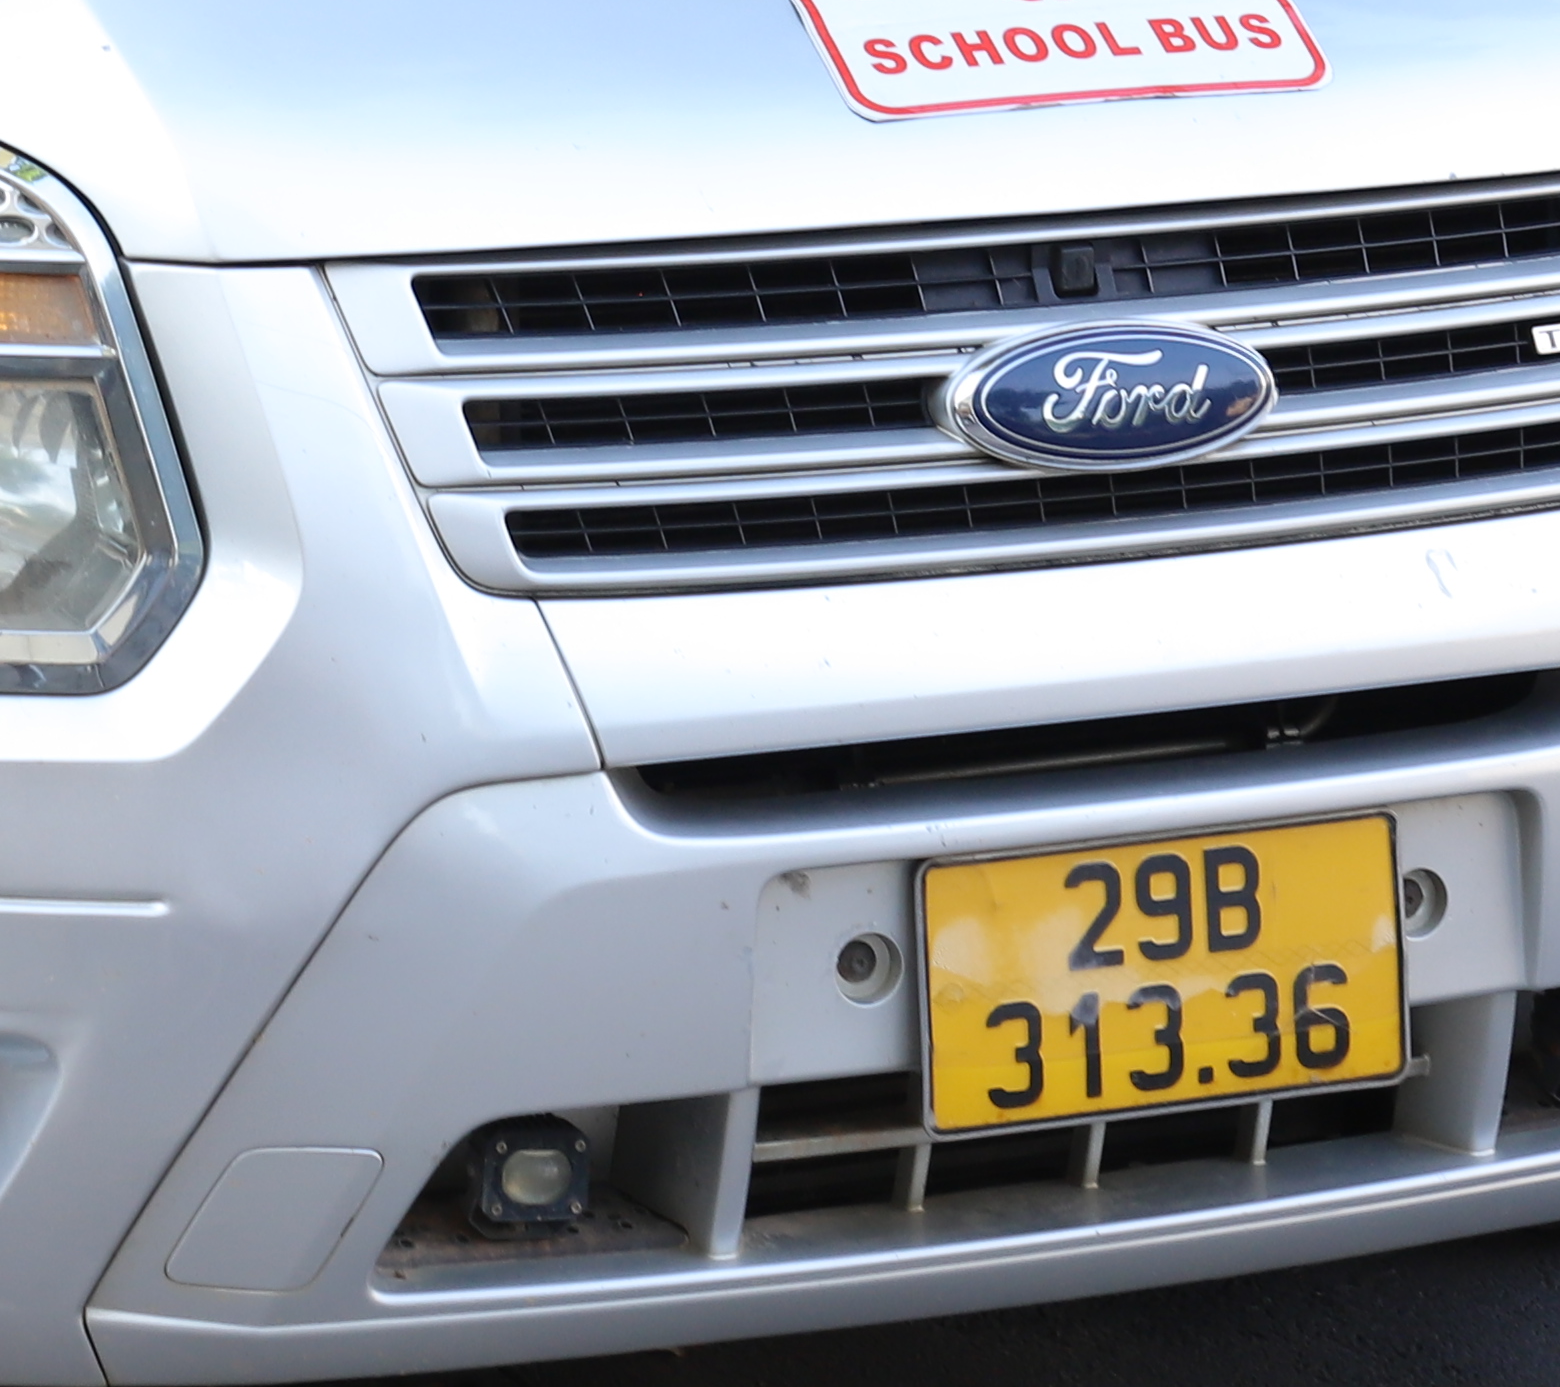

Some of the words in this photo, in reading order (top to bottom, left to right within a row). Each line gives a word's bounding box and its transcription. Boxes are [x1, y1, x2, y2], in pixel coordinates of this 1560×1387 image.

[863, 21, 1142, 75] SCHOOL
[1147, 13, 1283, 54] BUS
[1042, 348, 1213, 434] Ford
[1063, 844, 1264, 971] 29B
[985, 962, 1352, 1110] 313.36
